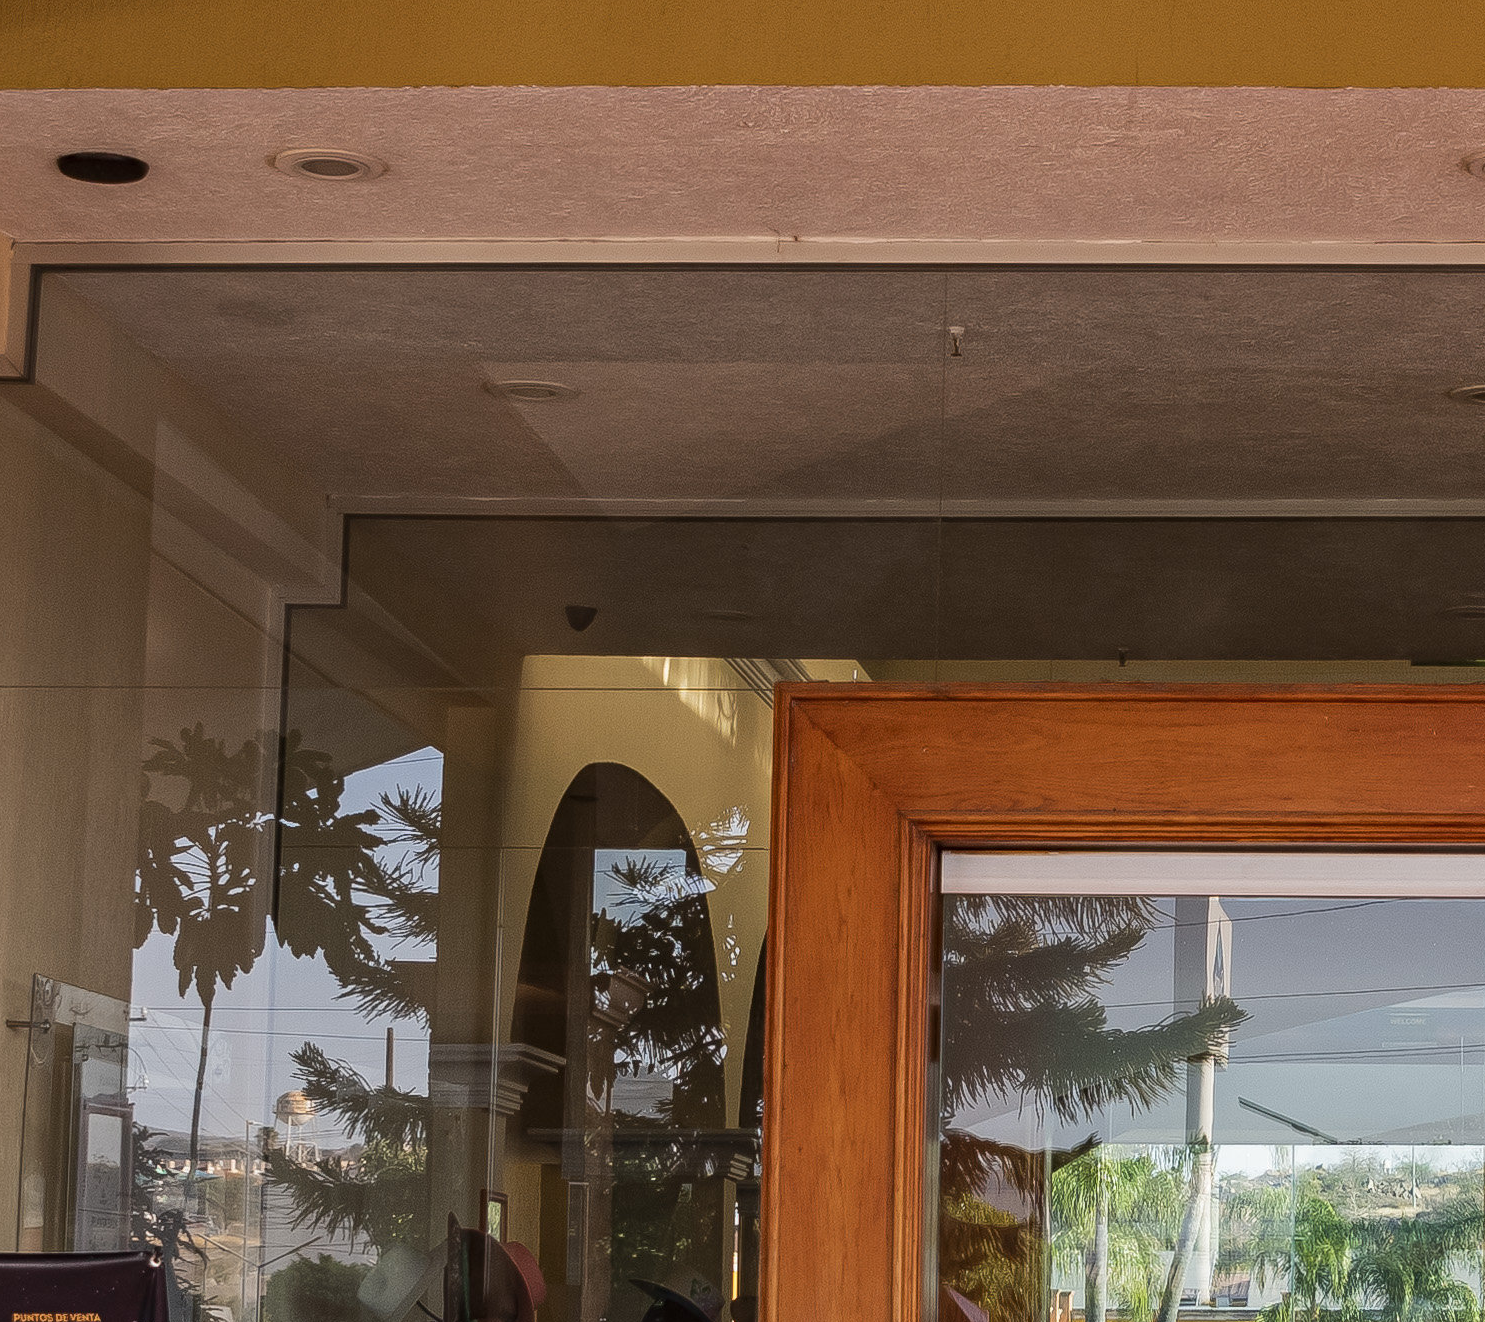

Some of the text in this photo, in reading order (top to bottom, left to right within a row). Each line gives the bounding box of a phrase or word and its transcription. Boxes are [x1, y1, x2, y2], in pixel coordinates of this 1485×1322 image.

[13, 1313, 101, 1322] PUNTOS DE VENTA
